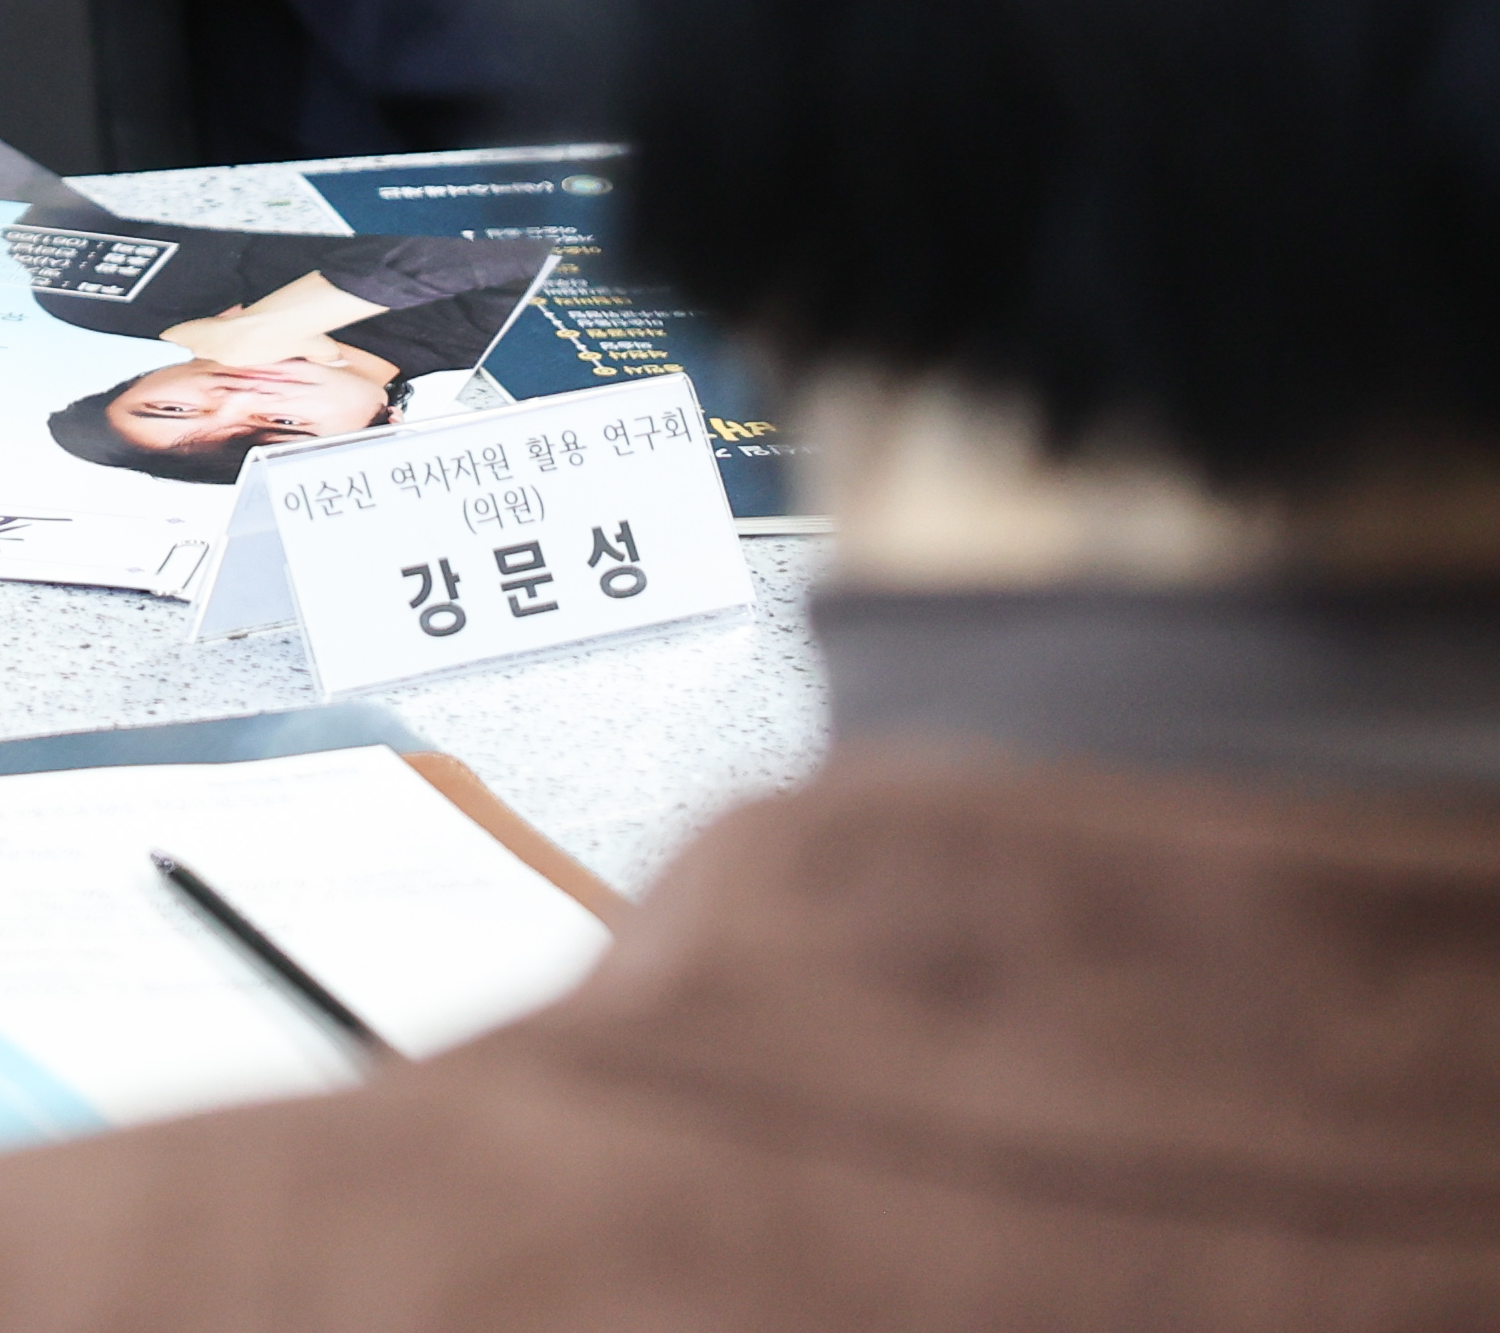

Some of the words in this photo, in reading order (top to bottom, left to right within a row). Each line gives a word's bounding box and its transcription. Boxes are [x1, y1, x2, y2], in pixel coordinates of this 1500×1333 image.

[282, 470, 378, 523] 이순신
[389, 443, 514, 501] 역사자원
[525, 428, 589, 474] 활용
[601, 405, 695, 458] 연구회
[462, 483, 547, 535] (의원)
